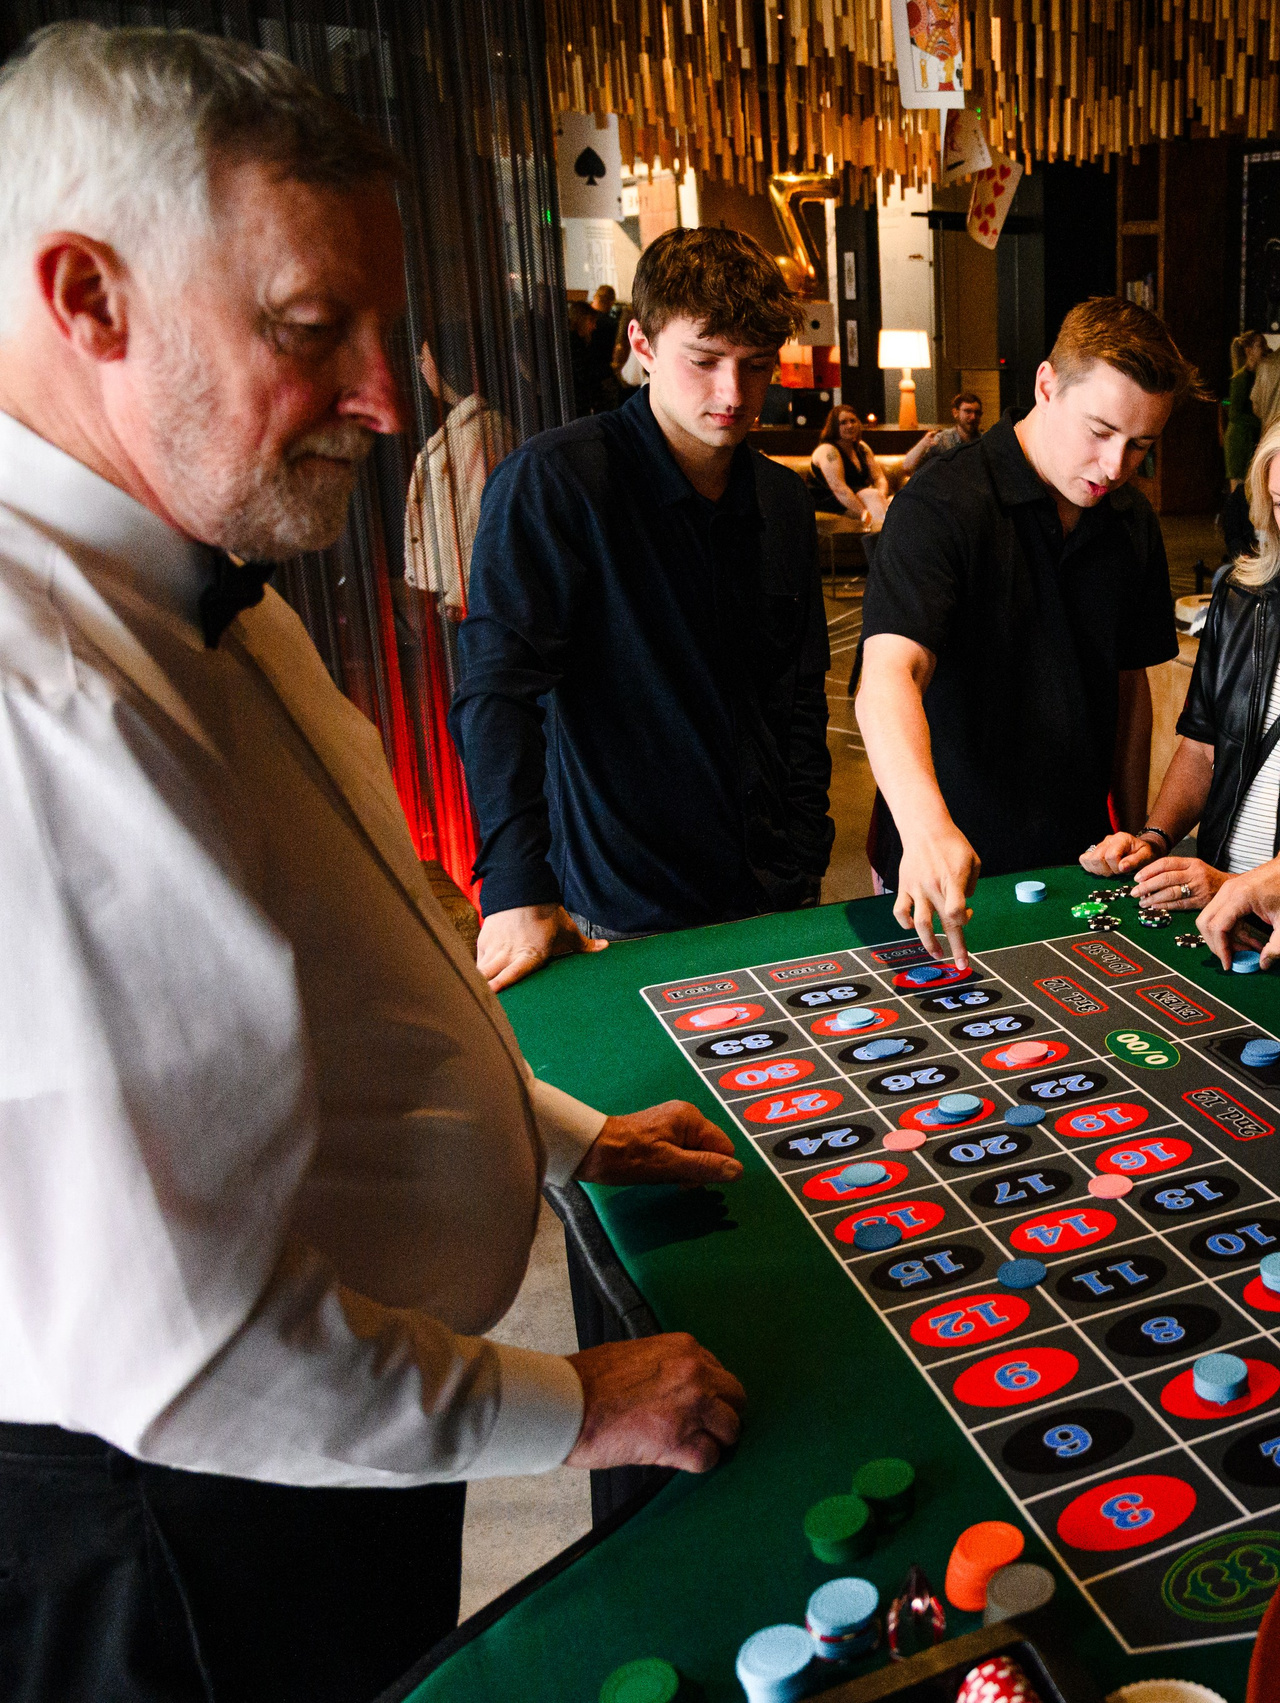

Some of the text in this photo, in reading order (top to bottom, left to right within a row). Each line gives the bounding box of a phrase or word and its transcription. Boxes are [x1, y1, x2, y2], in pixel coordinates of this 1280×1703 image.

[800, 986, 859, 1007] 35
[1042, 978, 1073, 993] 12
[932, 991, 990, 1010] 31
[1149, 989, 1204, 1020] EVEN
[962, 1016, 1023, 1037] 28
[710, 1033, 774, 1056] 33
[735, 1063, 800, 1087] 30
[880, 1067, 946, 1092] 26
[1030, 1073, 1095, 1099] 22
[765, 1092, 828, 1121] 27
[1191, 1089, 1229, 1109] 12
[1069, 1106, 1133, 1133] 19
[789, 1127, 860, 1156] 24
[949, 1134, 1018, 1163] 20
[1109, 1142, 1177, 1171] 16
[993, 1172, 1056, 1205] 17
[1154, 1180, 1224, 1210] 13
[1025, 1213, 1099, 1247] 14
[1205, 1223, 1277, 1256] 10
[888, 1249, 965, 1288] 15
[1071, 1260, 1149, 1296] 11
[928, 1300, 1010, 1339] 12
[1140, 1315, 1186, 1344] 8
[1100, 1492, 1156, 1531] 3
